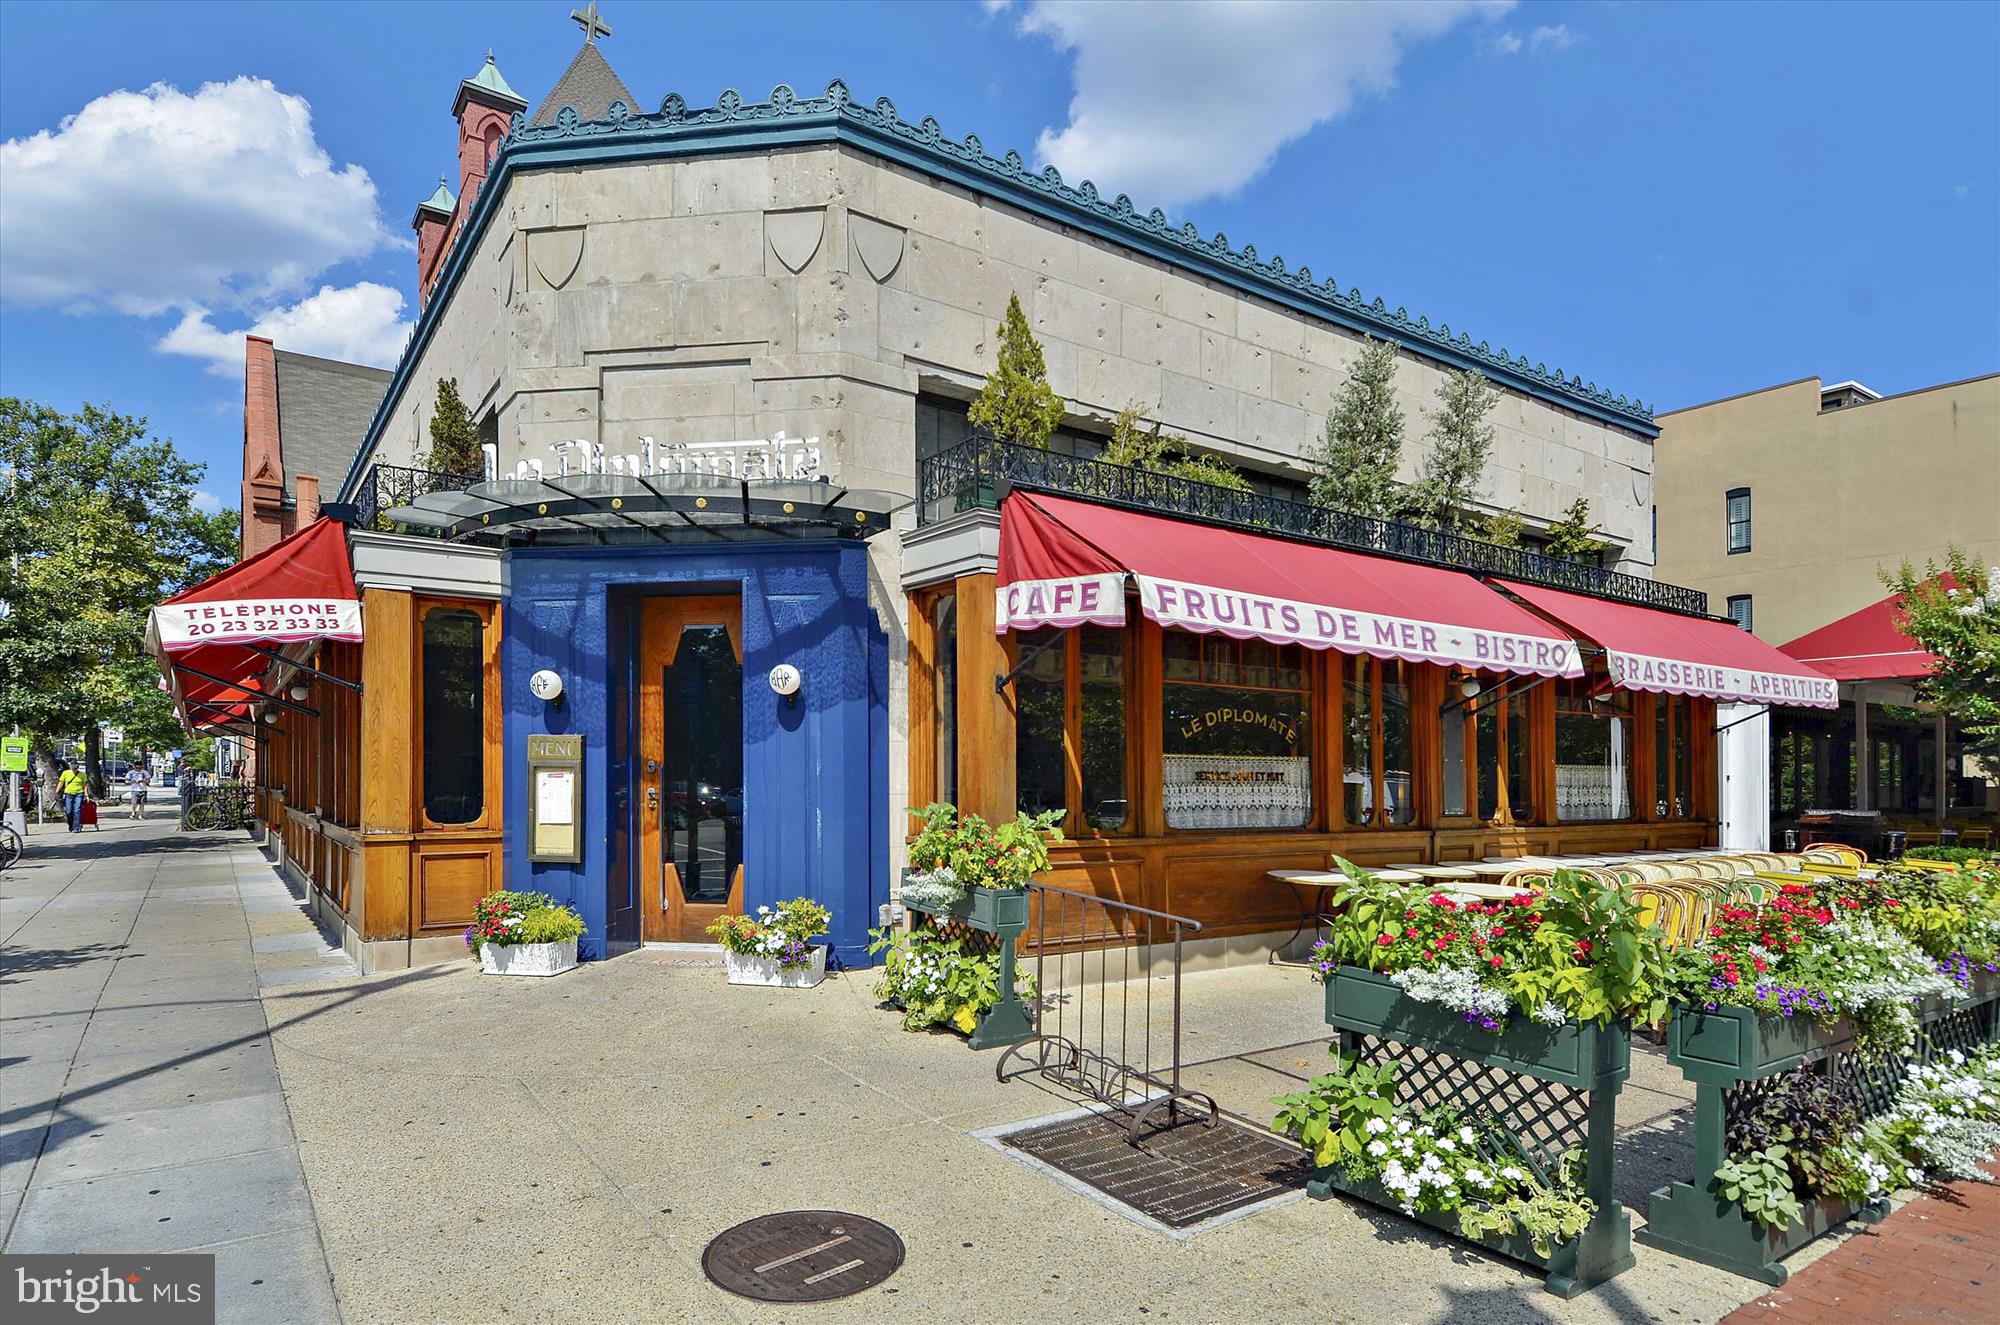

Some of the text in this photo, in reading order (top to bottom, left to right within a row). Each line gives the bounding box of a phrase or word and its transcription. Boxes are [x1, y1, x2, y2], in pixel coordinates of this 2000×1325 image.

[184, 603, 337, 620] TÉLÉPHONE
[1007, 581, 1100, 616] CAFE
[188, 618, 340, 636] 20 23 32 33 33
[1154, 583, 1300, 634] FRUITS
[1314, 610, 1360, 641] DE
[1372, 619, 1438, 652] MER
[1473, 633, 1567, 668] BISTRO
[1614, 655, 1726, 690] BRASSERIE
[1180, 708, 1297, 744] LE DIPLOMATE
[531, 741, 577, 756] MENU
[1255, 771, 1266, 781] ET
